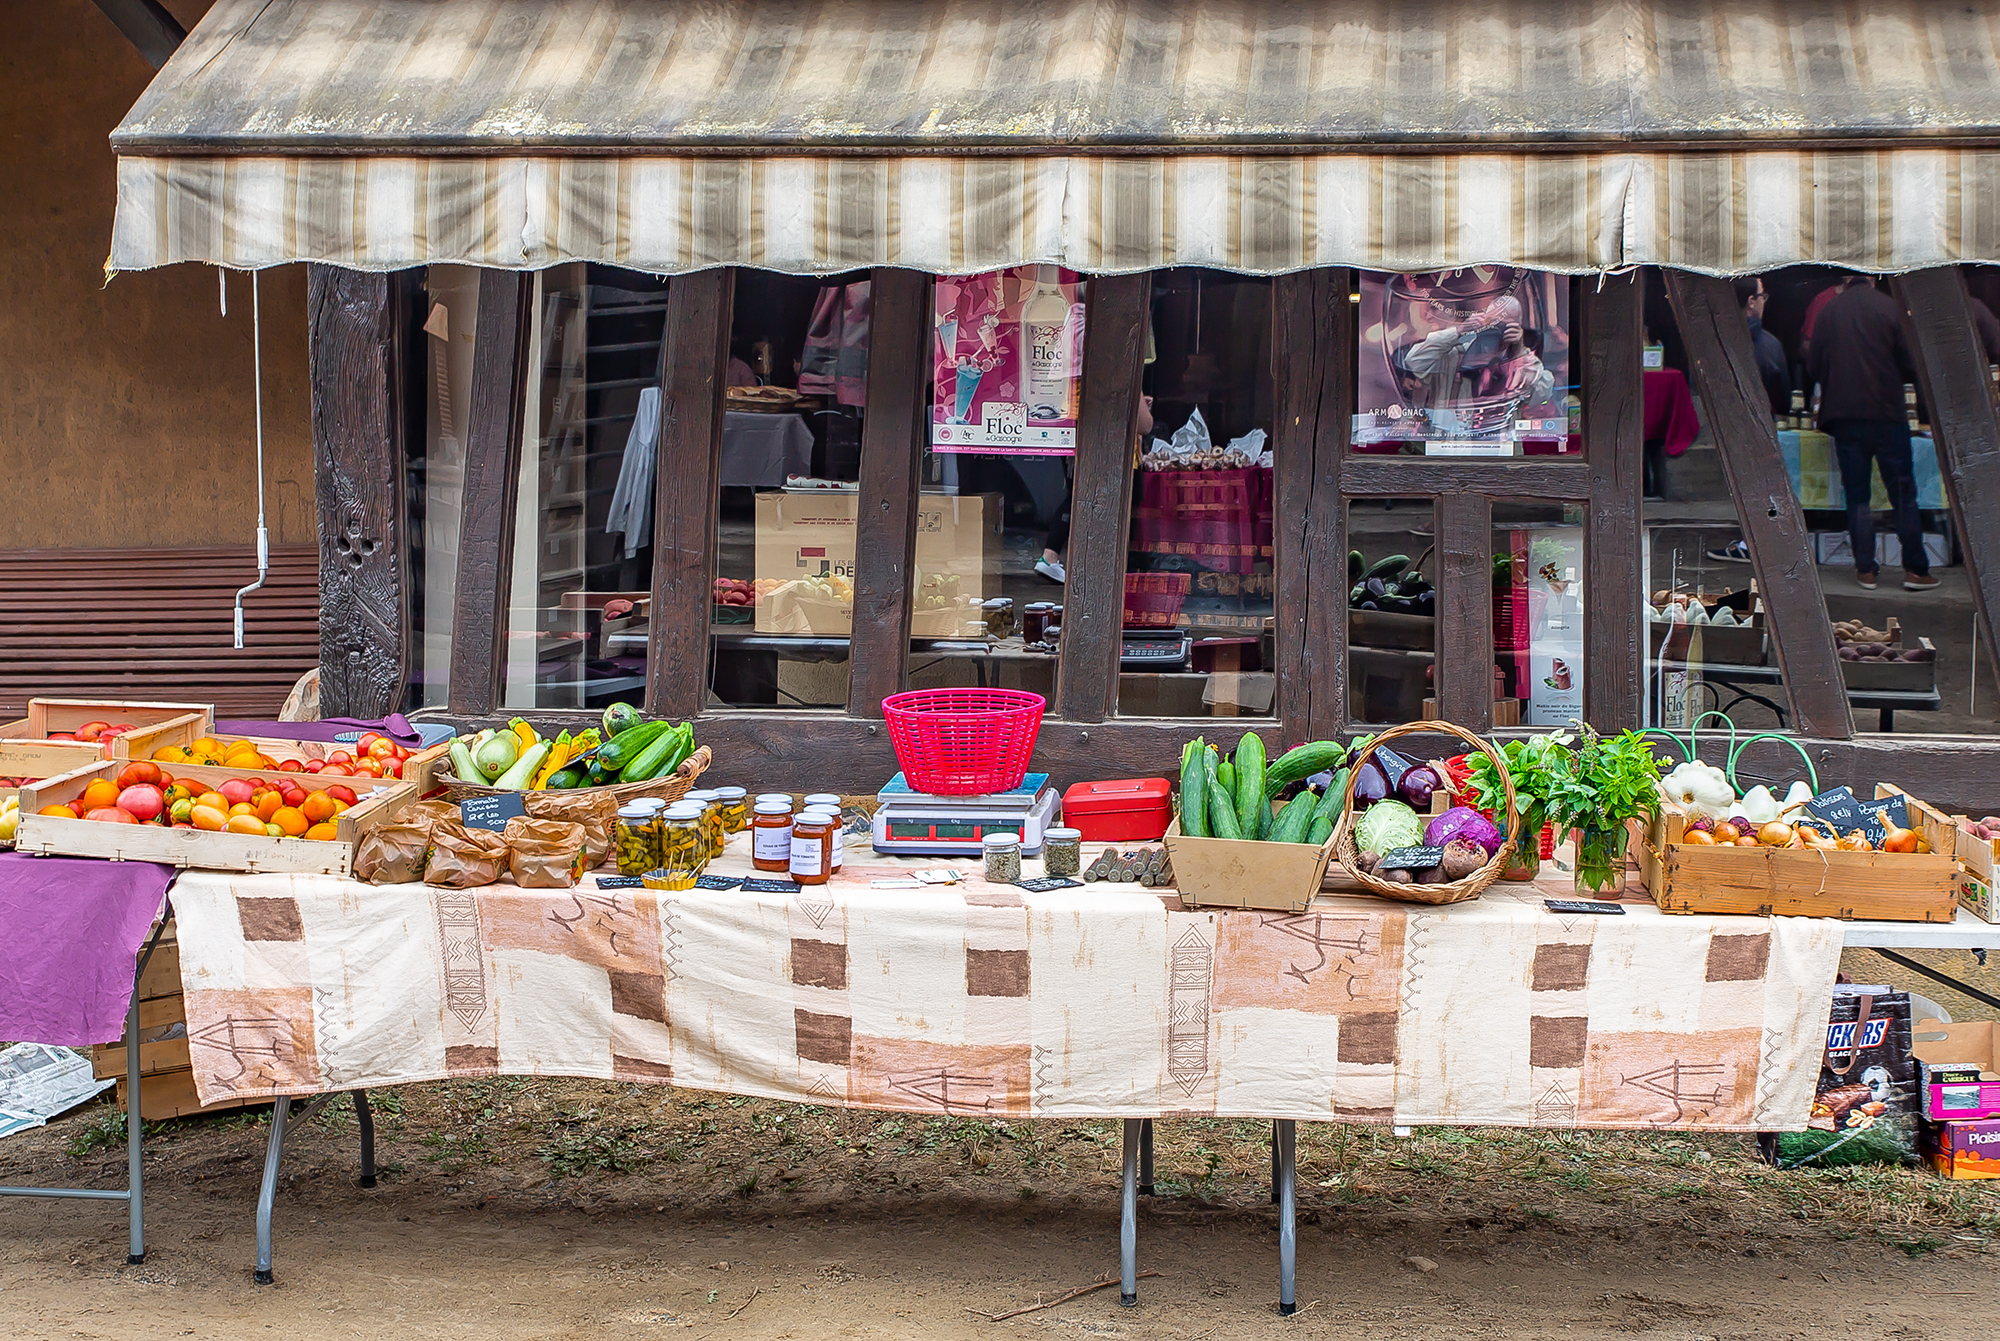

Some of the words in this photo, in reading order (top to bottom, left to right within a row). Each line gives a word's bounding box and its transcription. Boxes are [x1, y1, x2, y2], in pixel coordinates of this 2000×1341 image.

[1428, 297, 1445, 312] YEARS
[1509, 277, 1520, 290] THE
[1031, 345, 1063, 360] Floc
[1368, 404, 1424, 419] ARMAGNAC
[985, 417, 1023, 435] Floc
[990, 434, 1022, 444] Gascogne
[1891, 799, 1903, 808] de
[1800, 821, 1844, 831] Oignns
[1866, 814, 1894, 825] Tee
[1828, 1020, 1885, 1047] ICKRS
